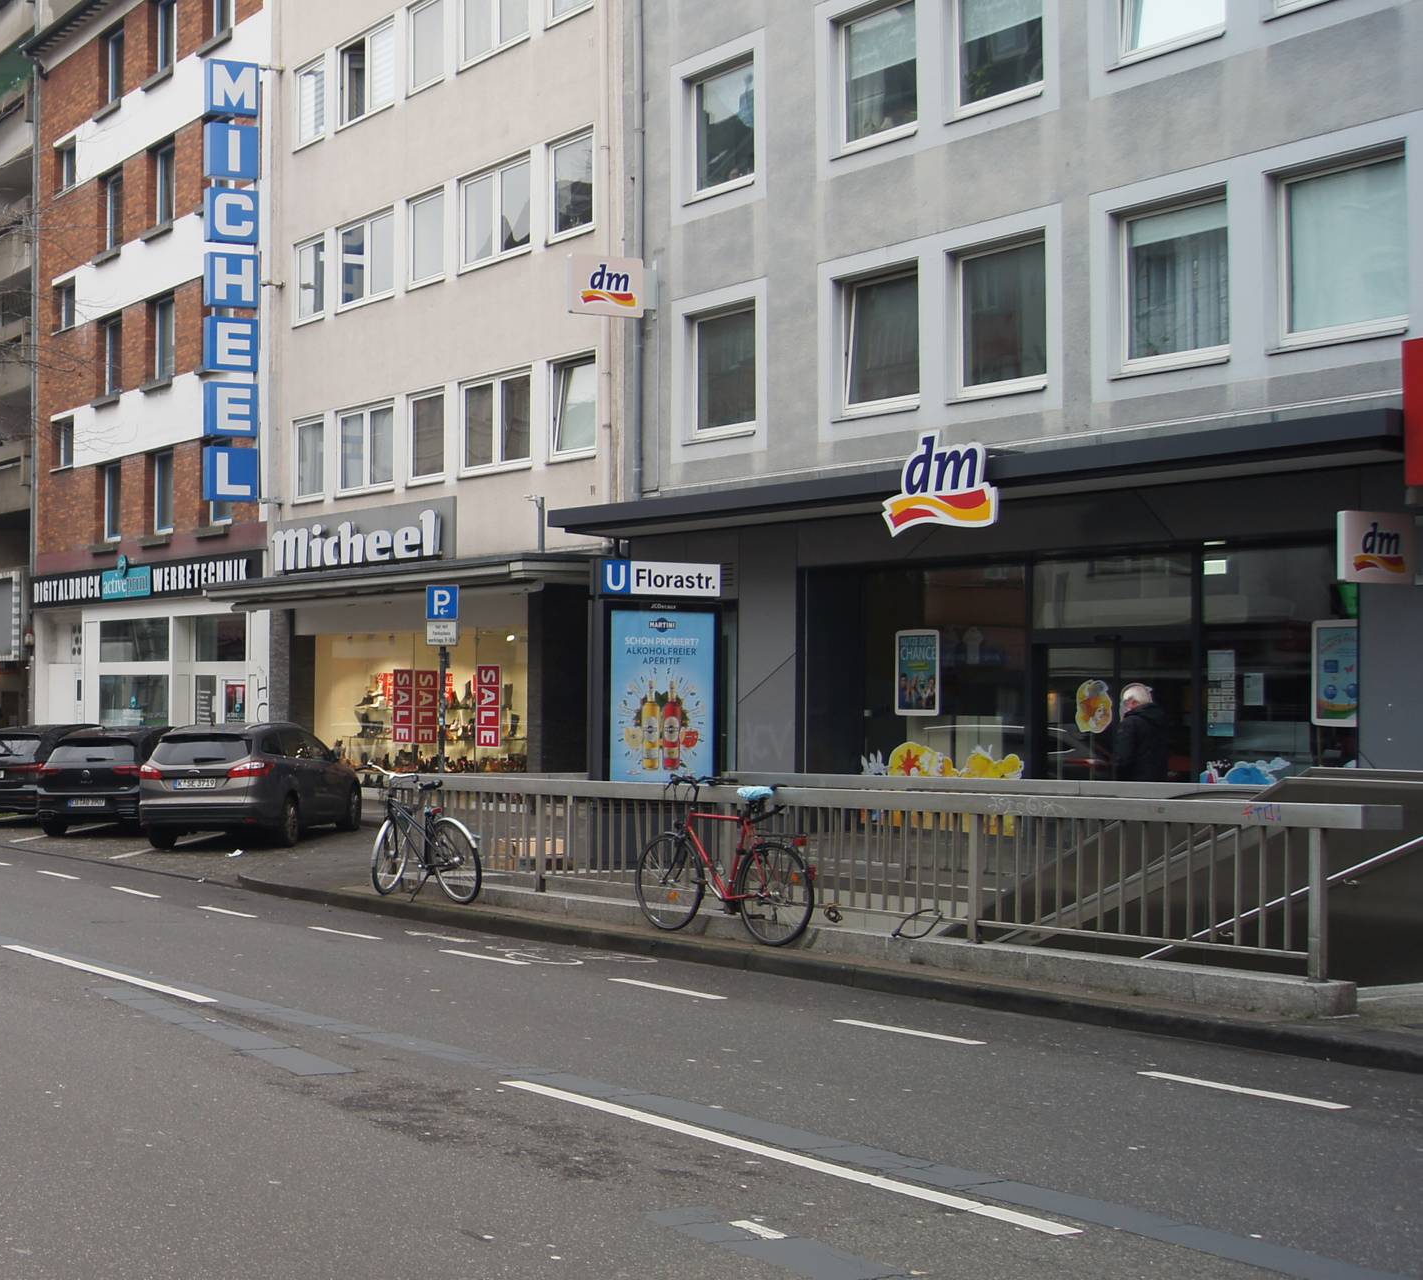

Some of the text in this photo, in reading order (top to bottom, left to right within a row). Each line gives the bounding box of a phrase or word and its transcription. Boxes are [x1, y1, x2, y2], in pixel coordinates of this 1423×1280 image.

[210, 63, 258, 497] MICHEEL
[590, 264, 630, 292] dm
[905, 436, 977, 496] dm
[272, 508, 443, 572] Micheel
[1362, 522, 1399, 556] dm
[34, 575, 100, 603] DIGITALDRUCK
[153, 558, 247, 592] WERBETECHNIK
[636, 568, 716, 589] Florastr.
[434, 590, 450, 615] P
[649, 621, 676, 629] MARTINI
[626, 648, 697, 656] ALKOHOLFREIER
[642, 657, 682, 665] APERITIF
[900, 647, 936, 660] CHANCE
[397, 673, 410, 740] SALE
[418, 674, 434, 741] SALE
[480, 669, 496, 744] SALE
